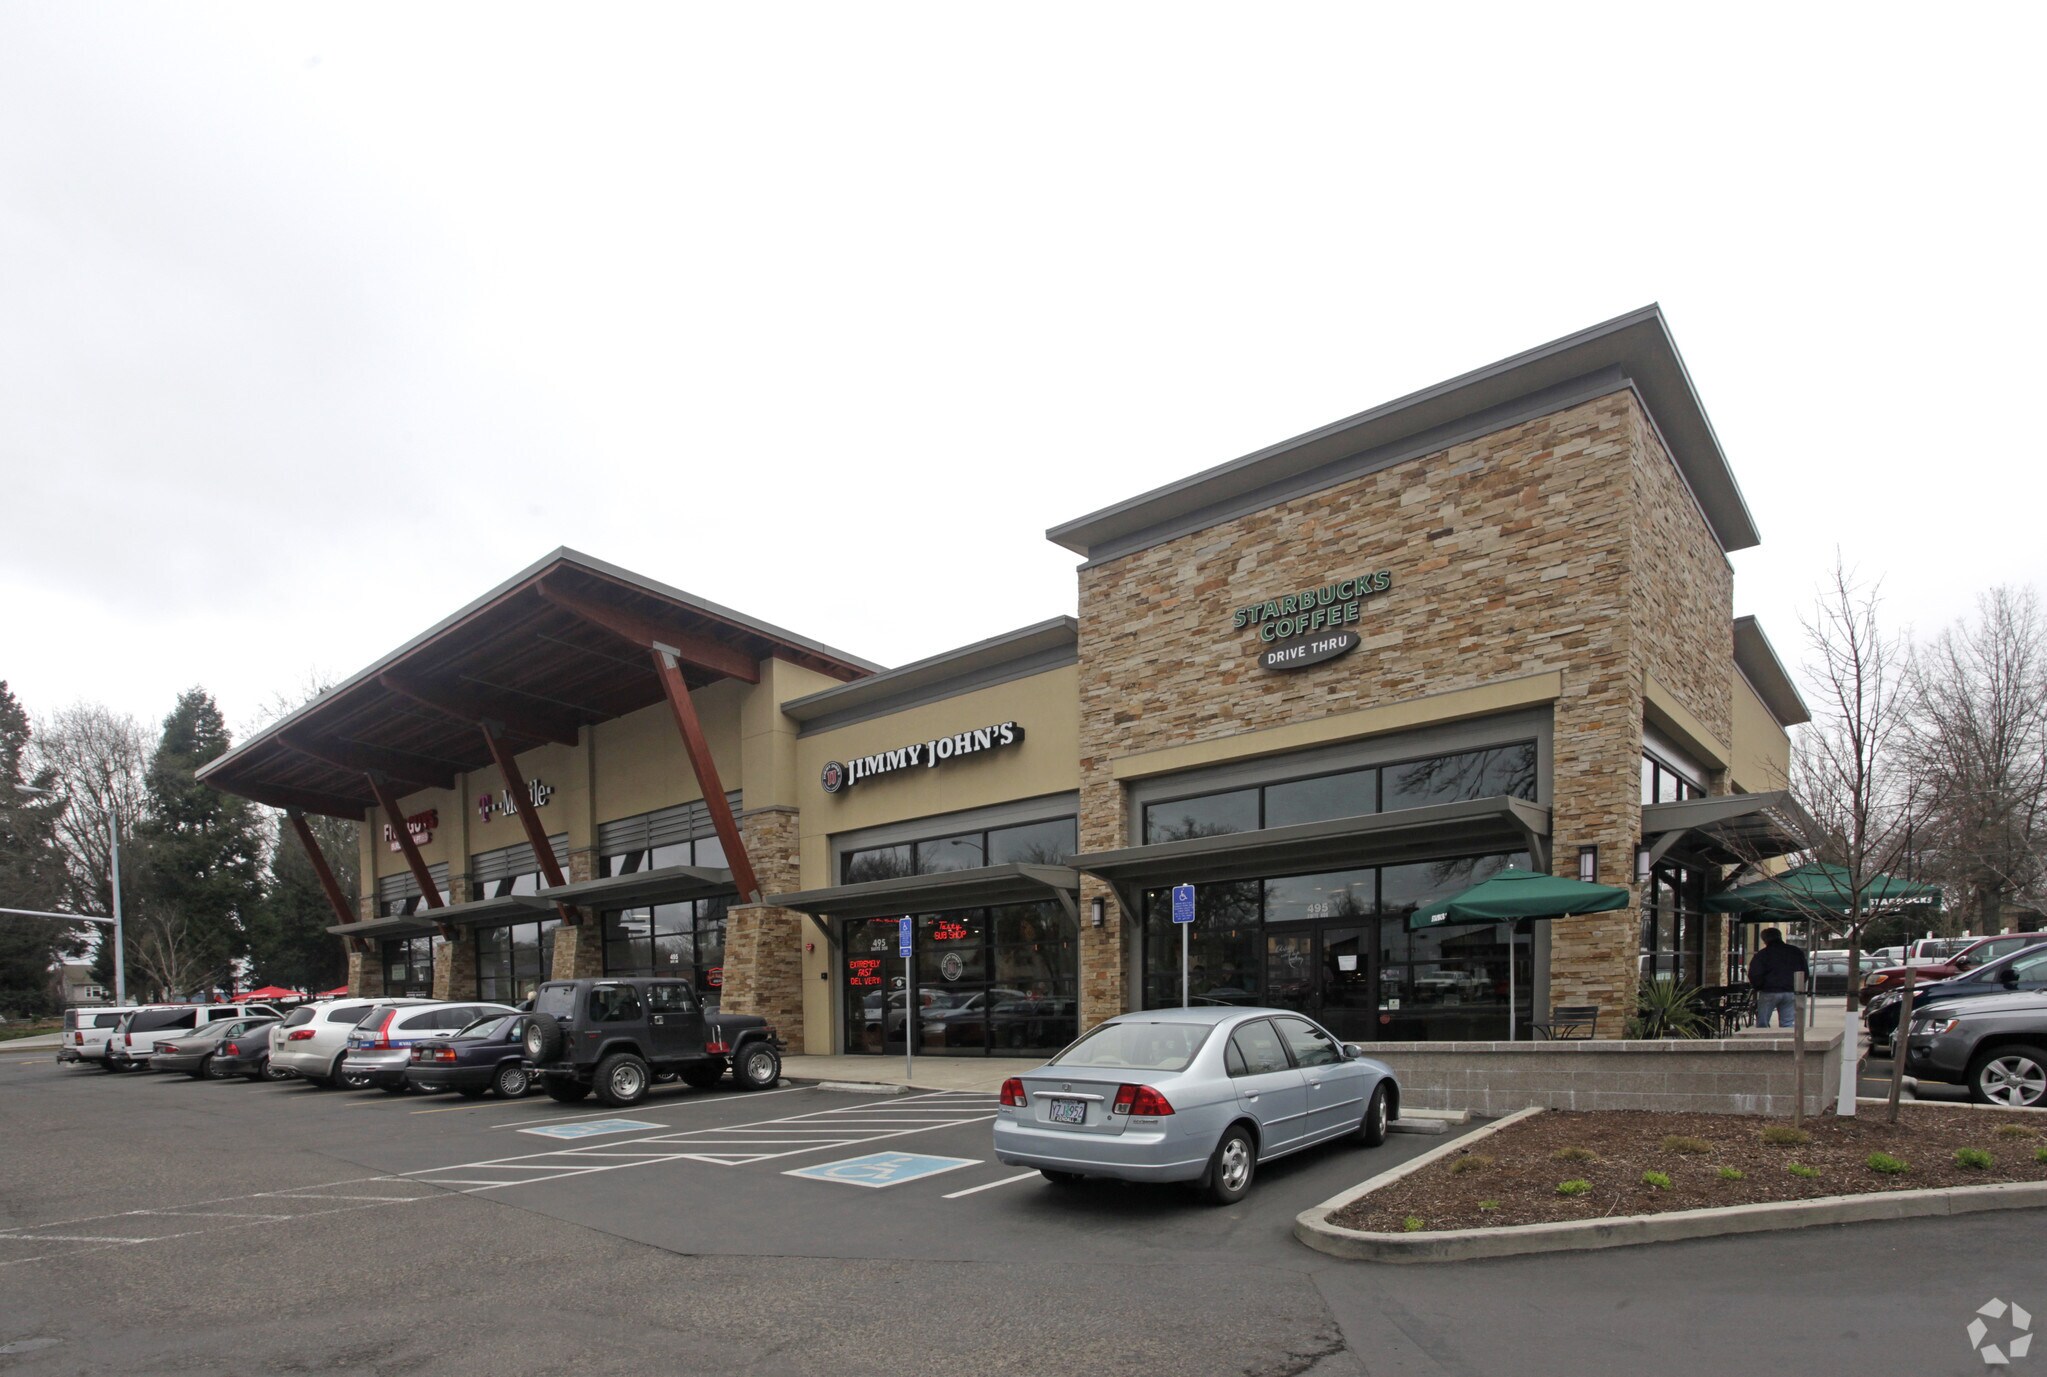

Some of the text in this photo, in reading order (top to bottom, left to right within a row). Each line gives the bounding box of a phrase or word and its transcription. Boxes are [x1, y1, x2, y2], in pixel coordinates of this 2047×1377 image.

[1232, 569, 1391, 628] STARBUCKS
[1260, 601, 1360, 642] COFFEE
[1267, 635, 1347, 665] DRIVE THRU
[848, 744, 923, 786] JIMMY
[927, 721, 1015, 768] JOHN'S
[1307, 903, 1329, 913] 495
[934, 930, 966, 940] SUB SHOP
[872, 938, 886, 947] 495
[849, 960, 880, 969] EXTREMELY
[857, 968, 873, 977] FAST
[1052, 1104, 1084, 1119] YZJ 952
